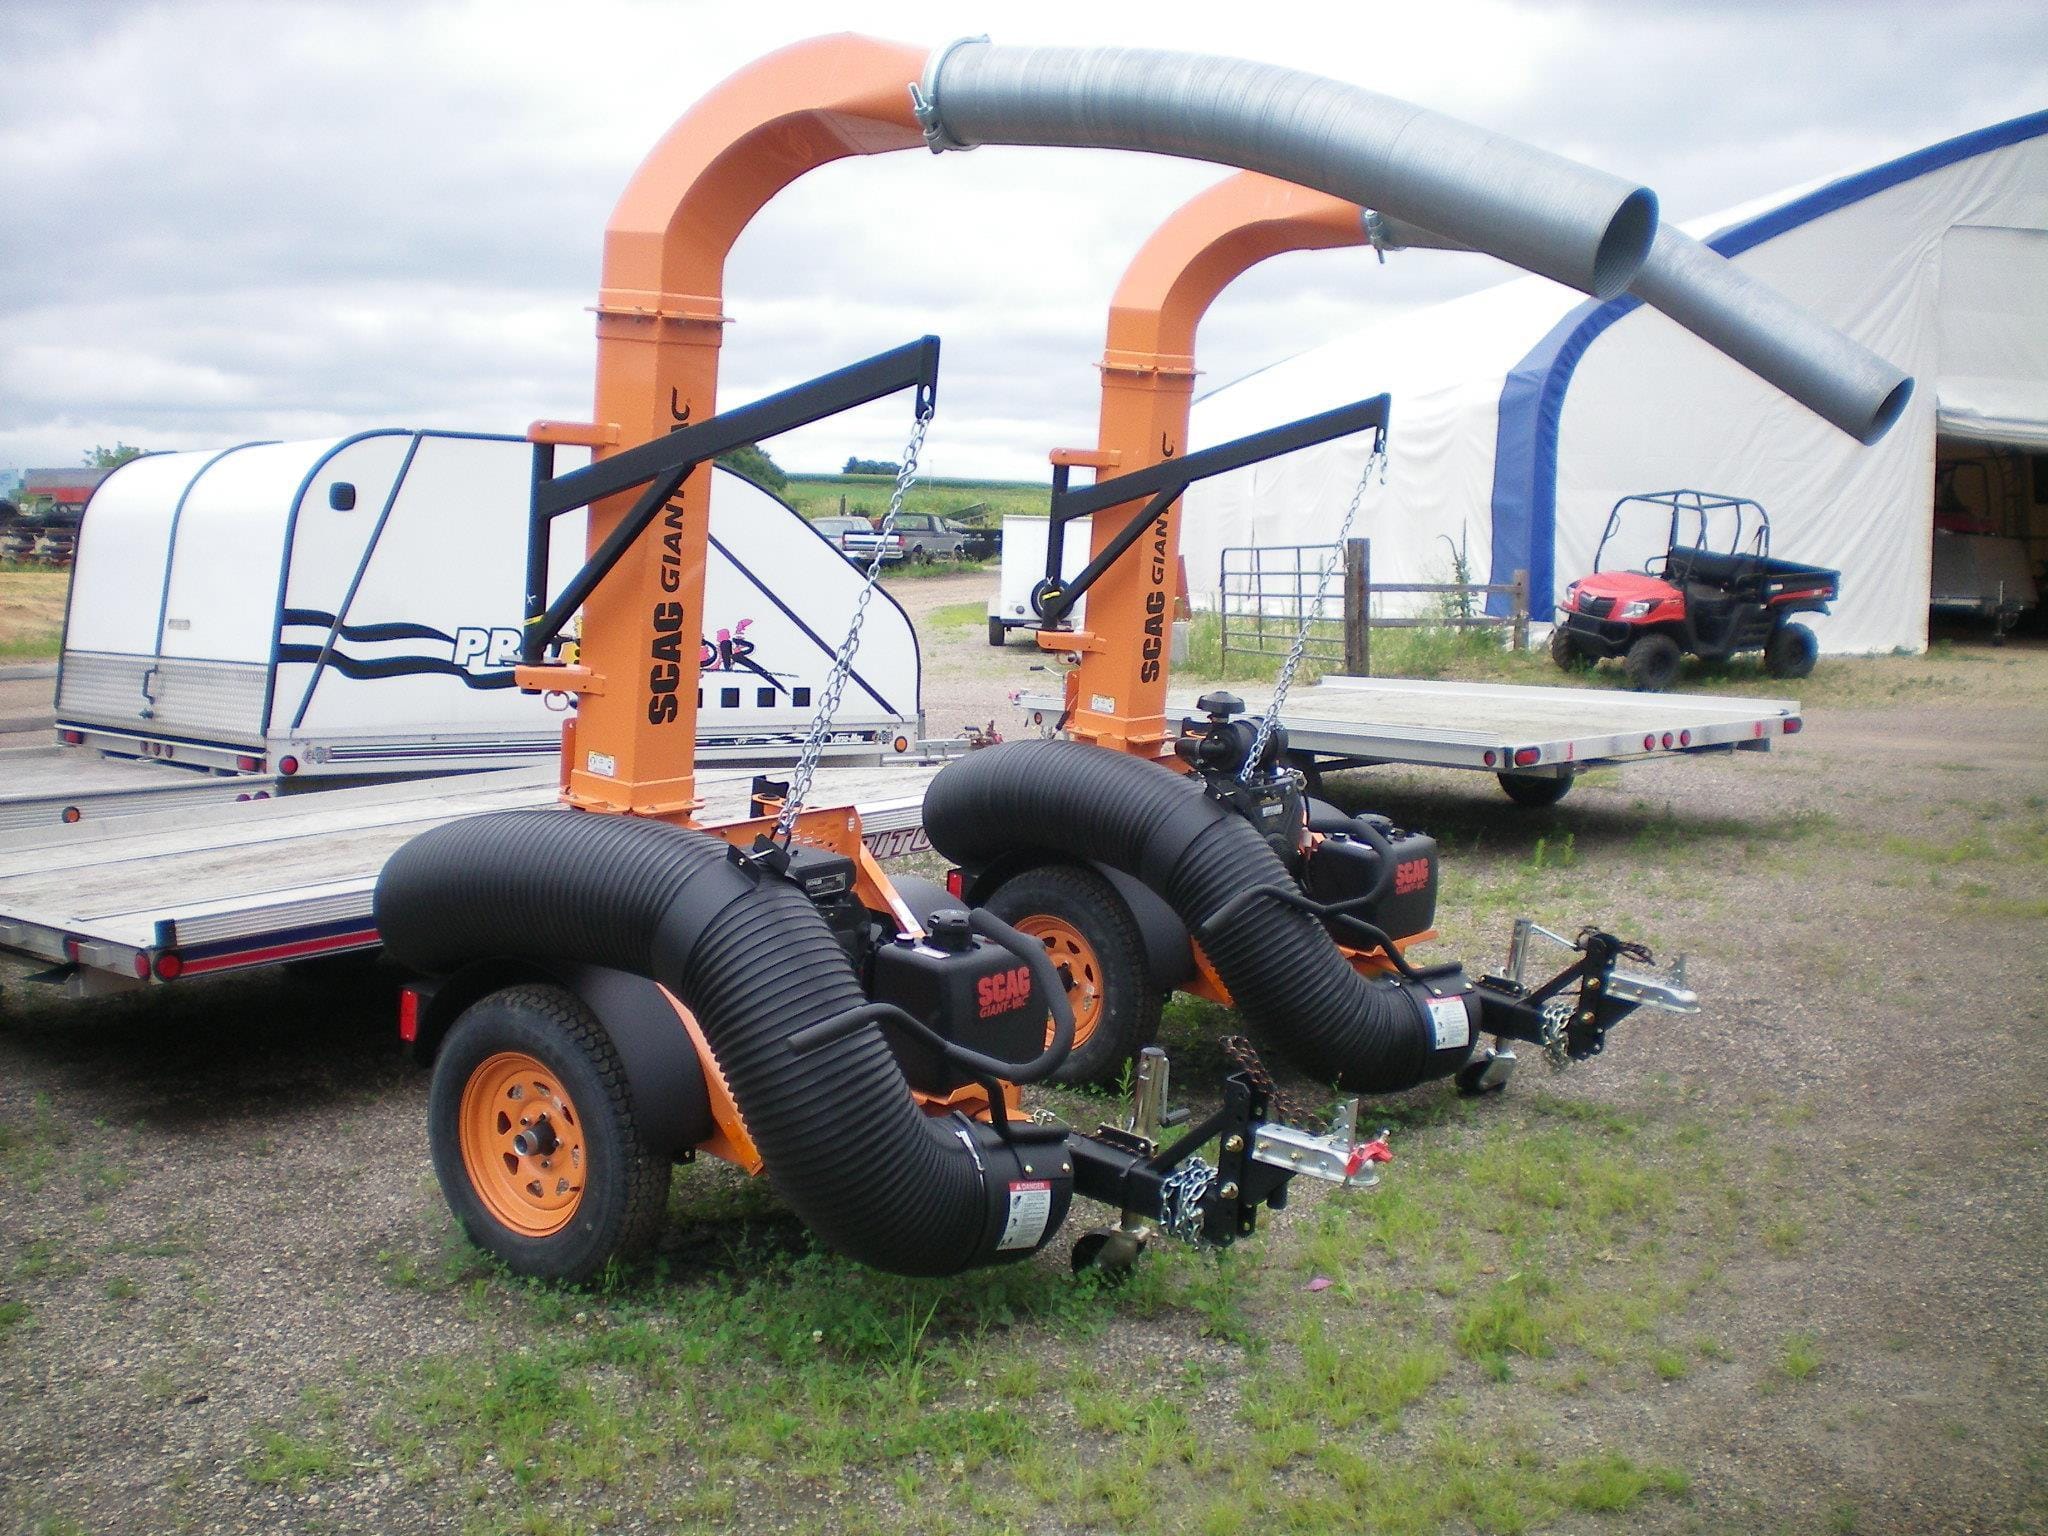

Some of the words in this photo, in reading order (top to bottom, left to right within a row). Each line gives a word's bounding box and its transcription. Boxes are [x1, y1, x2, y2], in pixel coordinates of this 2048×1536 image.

[452, 626, 524, 667] PR
[1140, 591, 1166, 684] SCAG
[649, 601, 684, 725] SCAG
[1395, 857, 1429, 887] SCAG
[977, 965, 1031, 1008] SCAG
[1021, 1182, 1046, 1191] DANGER
